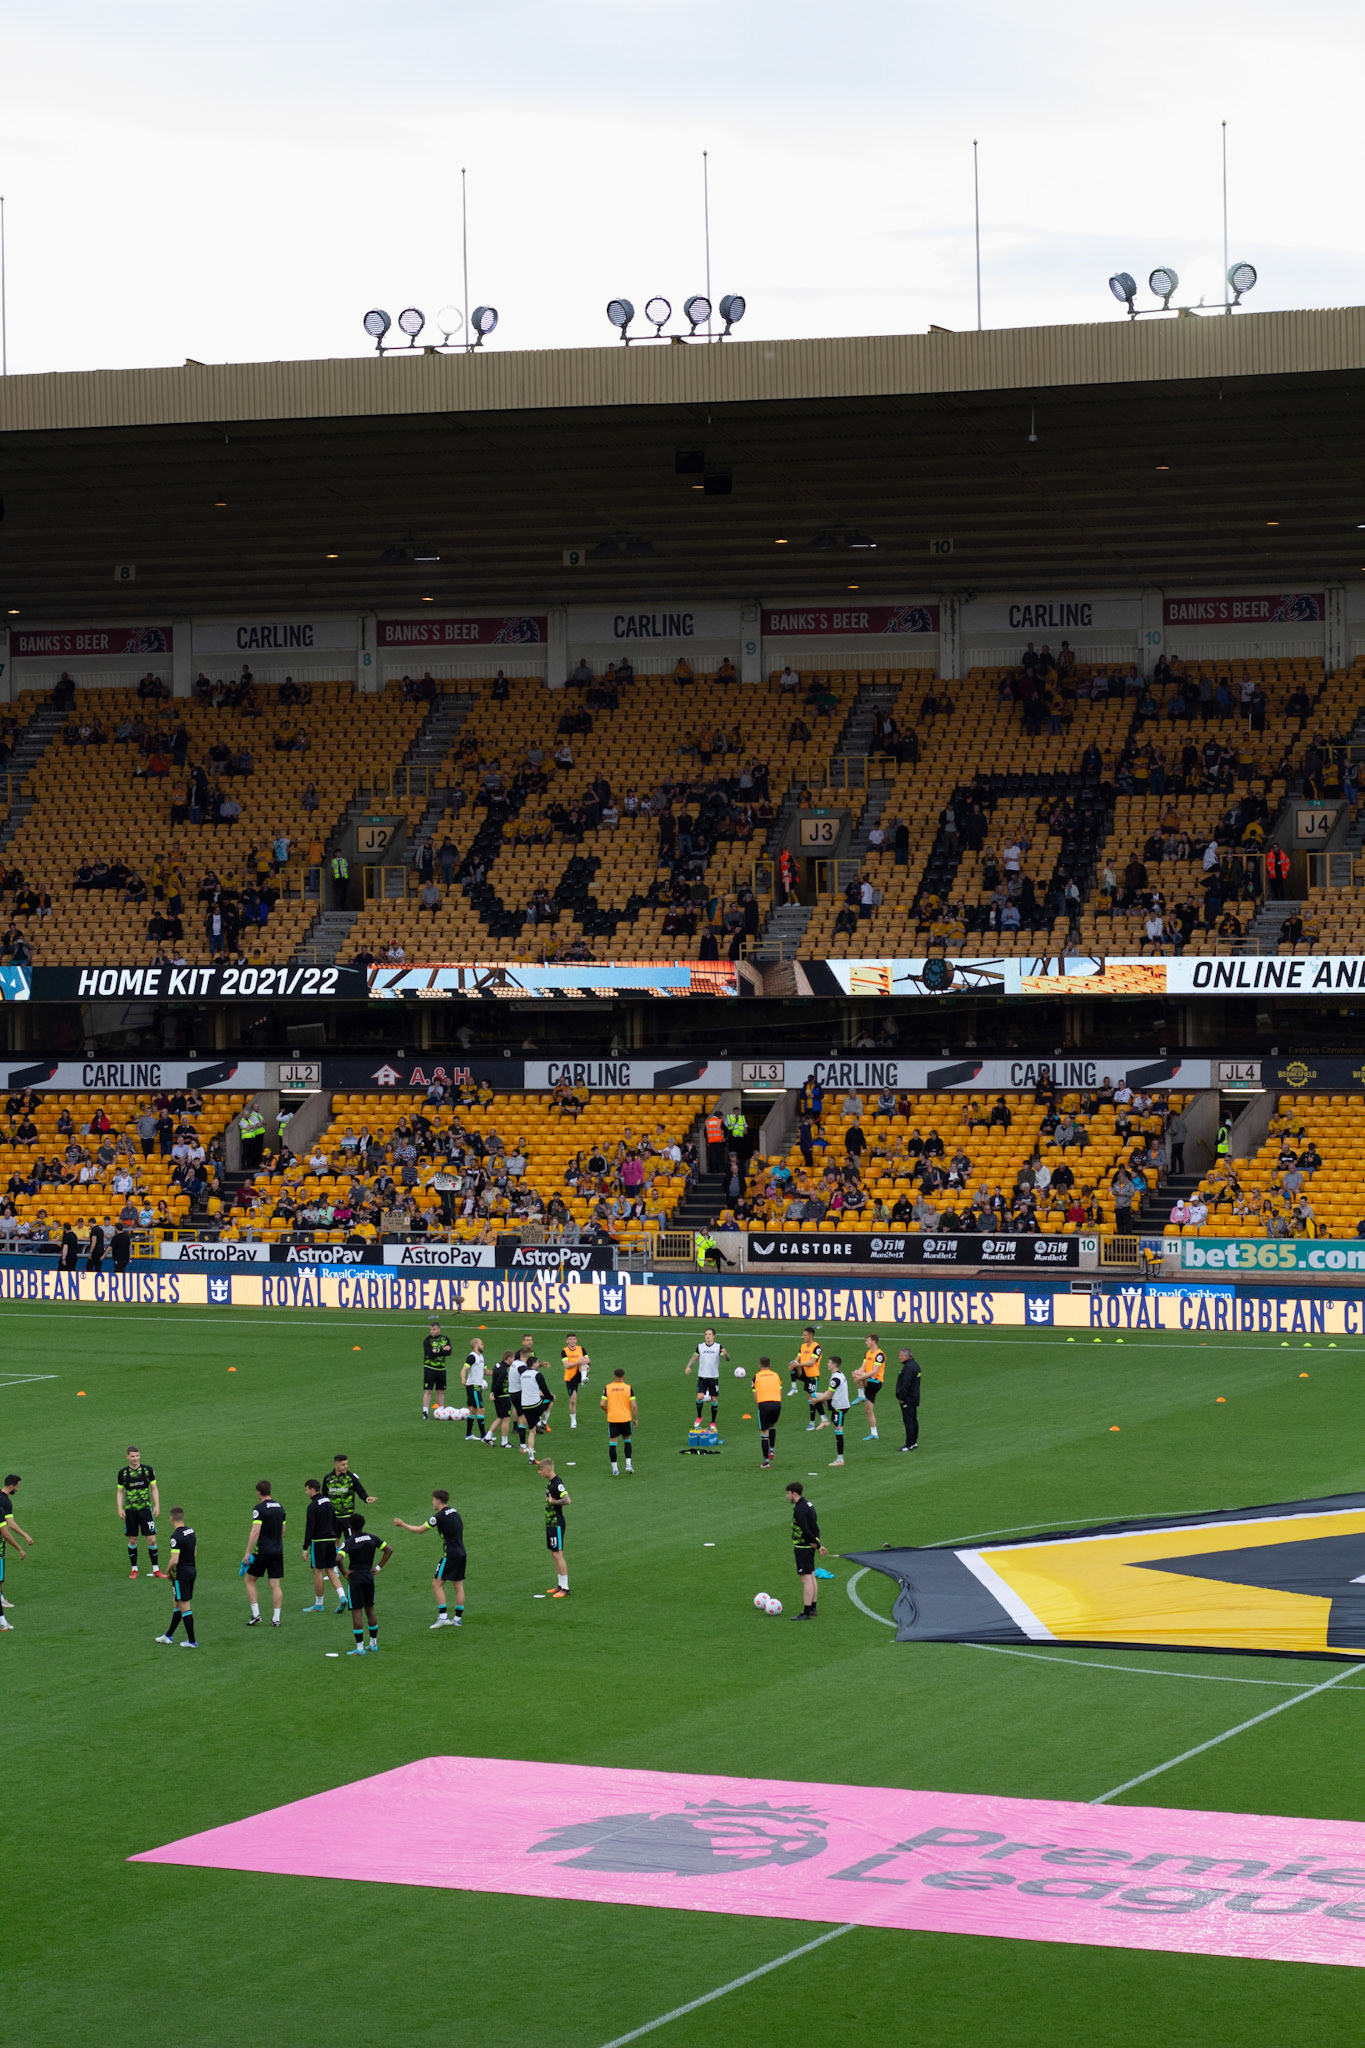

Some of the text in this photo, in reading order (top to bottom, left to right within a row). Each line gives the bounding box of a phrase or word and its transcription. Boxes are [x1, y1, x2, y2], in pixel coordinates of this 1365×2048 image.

[934, 541, 951, 554] 10
[569, 551, 580, 565] 9
[120, 566, 129, 580] 8
[1009, 603, 1092, 628] CARLING
[1169, 600, 1270, 621] BANKS'S BEER
[614, 613, 694, 638] CARLING
[771, 612, 869, 631] BANKS'S BEER
[237, 624, 313, 649] CARLING
[385, 623, 480, 642] BANKS'S BEER
[1145, 631, 1161, 646] 10
[19, 634, 109, 652] BANKS'S BEER
[746, 641, 757, 656] 9
[363, 653, 371, 667] 8
[809, 823, 833, 841] J3
[1305, 815, 1330, 834] J4
[366, 830, 388, 848] J2
[78, 967, 340, 996] HOME KIT 2021/22
[1193, 960, 1306, 989] ONLINE
[83, 1063, 162, 1087] CARLING
[286, 1066, 313, 1081] JL2
[547, 1062, 631, 1087] CARLING
[748, 1064, 778, 1080] JL3
[813, 1062, 899, 1087] CARLING
[1227, 1064, 1256, 1080] JL4
[779, 1243, 853, 1255] CASTORE
[1081, 1240, 1095, 1251] 10
[1167, 1242, 1178, 1253] 11
[401, 1246, 482, 1267] AstroPay
[512, 1248, 593, 1271] AstroPay
[94, 1271, 180, 1304] CRUISES
[263, 1275, 327, 1308] ROYAL
[478, 1281, 571, 1314] CRUISES
[659, 1285, 729, 1318] ROYAL
[894, 1291, 994, 1325] CRUISES
[1090, 1294, 1166, 1329] ROYAL
